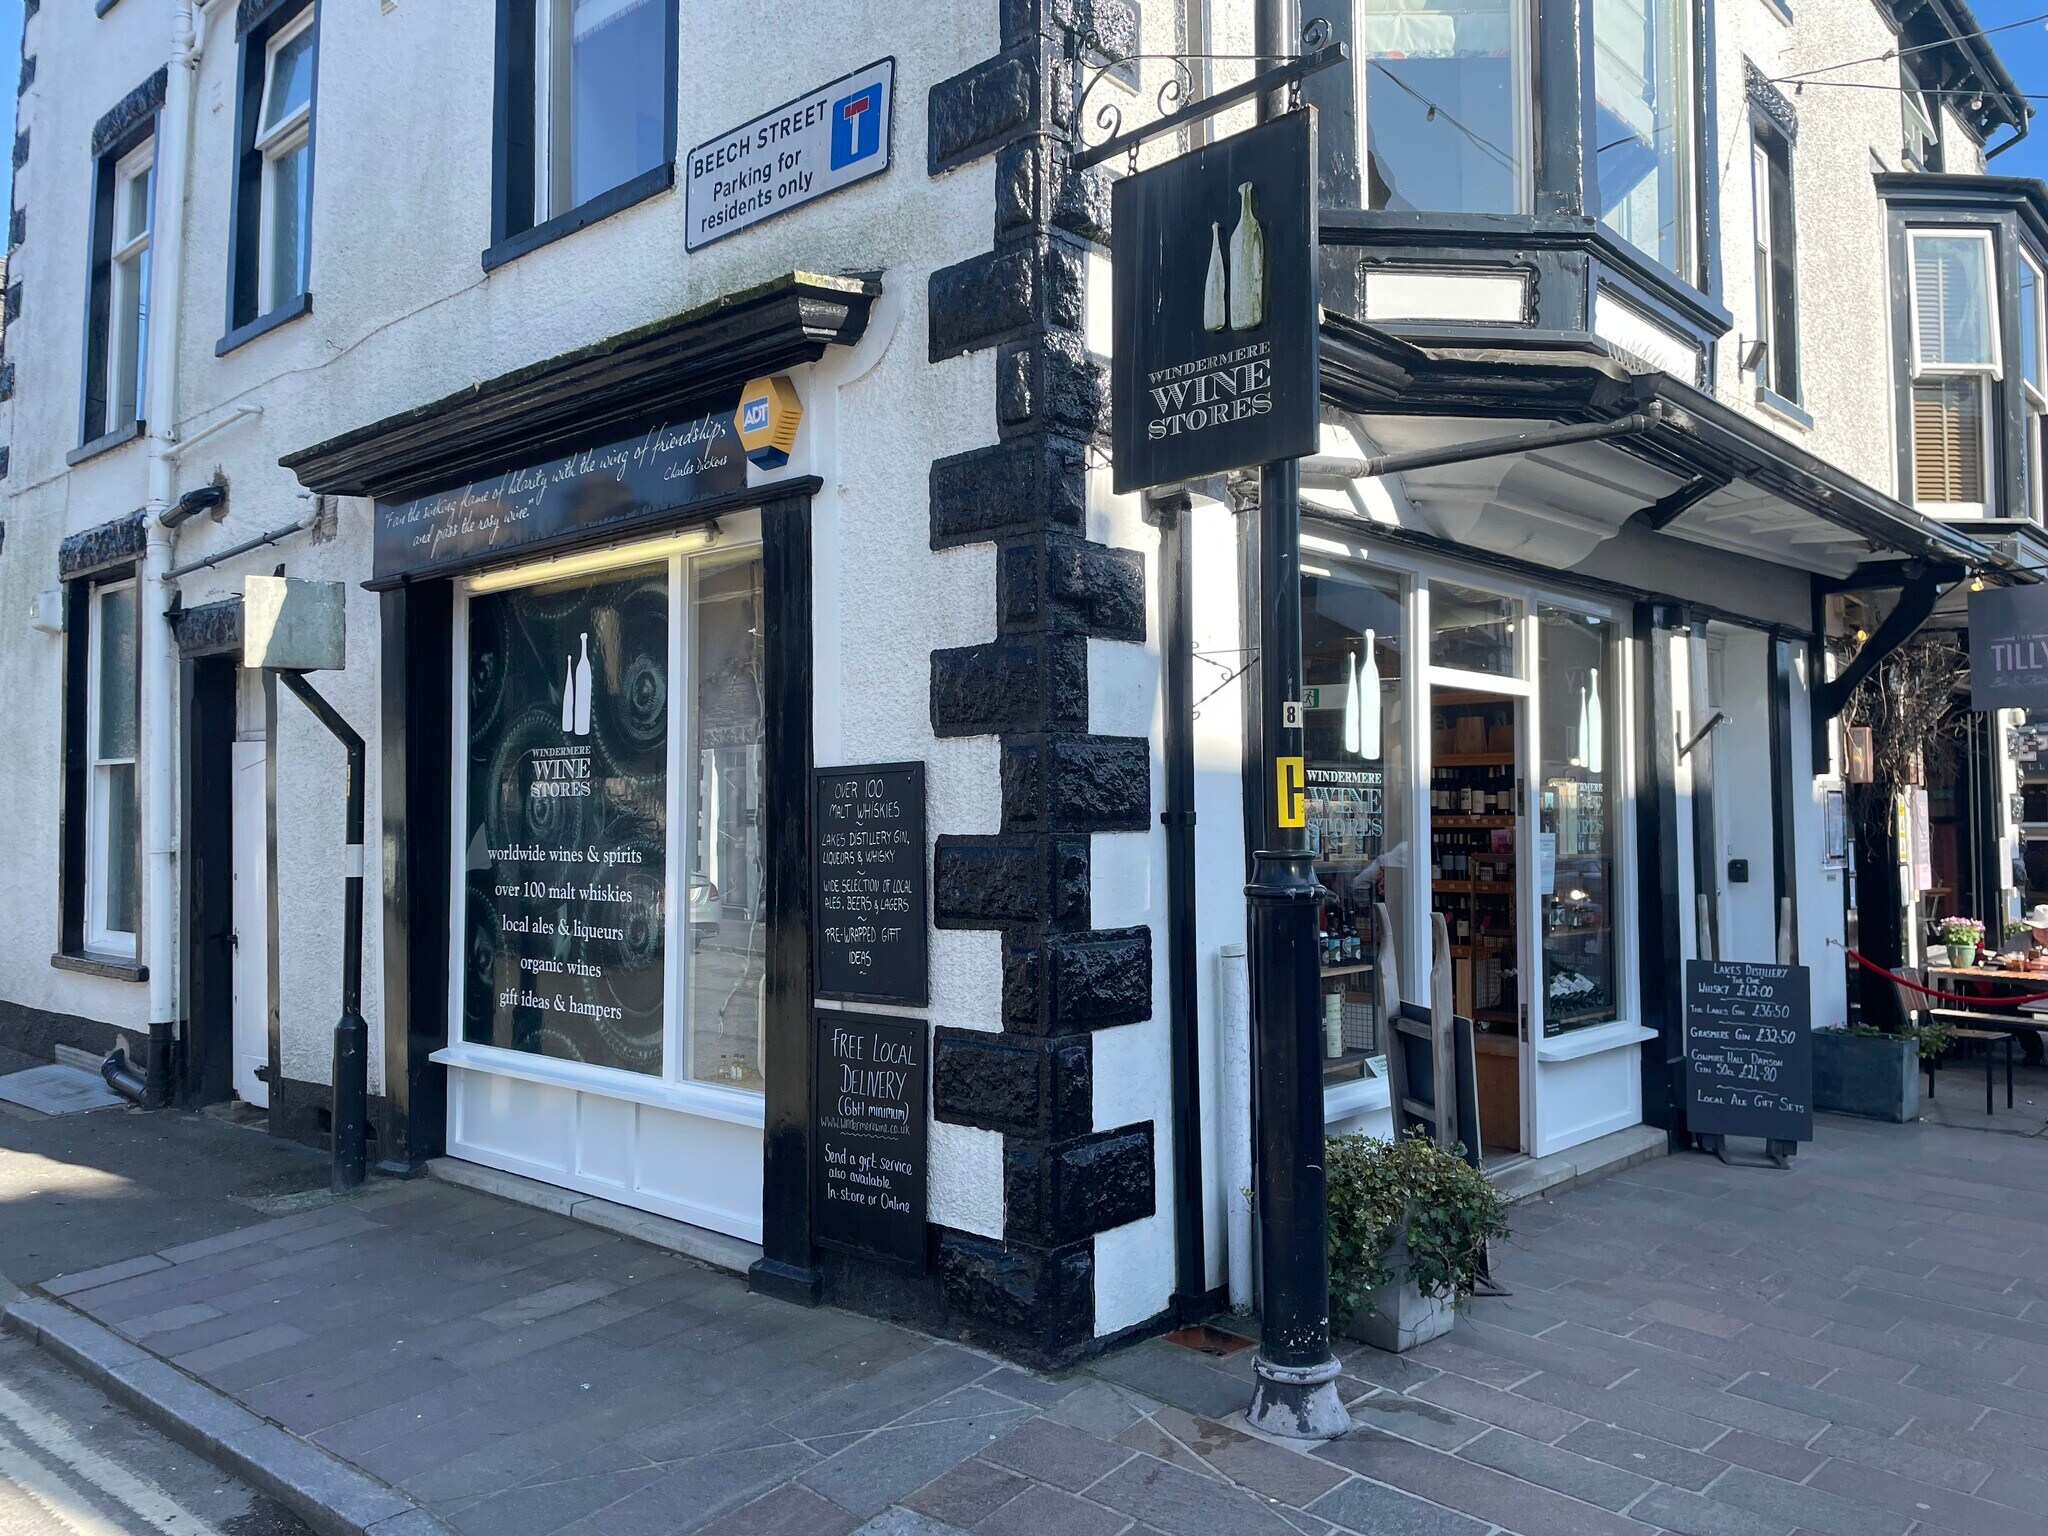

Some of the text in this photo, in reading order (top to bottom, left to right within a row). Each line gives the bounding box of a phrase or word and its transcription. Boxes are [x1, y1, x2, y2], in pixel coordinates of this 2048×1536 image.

[694, 99, 828, 179] BEECH STREET
[713, 150, 802, 201] Parking for
[701, 170, 813, 232] residents only
[1148, 341, 1271, 385] WINDERMERE
[1149, 358, 1271, 414] WINE
[744, 403, 769, 428] ADT
[1147, 391, 1273, 441] STORES
[407, 500, 420, 524] the
[423, 499, 457, 528] sinking
[458, 480, 489, 519] flame
[492, 469, 511, 508] of
[508, 468, 548, 506] hilarity
[552, 452, 578, 483] with
[579, 448, 596, 474] the
[600, 449, 629, 482] wing
[634, 425, 656, 469] of
[663, 455, 728, 481] Charles Dickens
[413, 523, 434, 546] and
[430, 527, 458, 559] pass
[461, 510, 475, 534] the
[477, 514, 500, 545] rosy
[1286, 705, 1297, 724] 8
[532, 745, 591, 757] WINDERMERE
[531, 758, 591, 780] WINE
[1305, 769, 1382, 784] WINDERMERE
[530, 781, 591, 798] STORES
[835, 779, 884, 799] OVER 100
[1307, 786, 1382, 814] WINE
[829, 800, 900, 819] MALT WHISKIES
[822, 832, 846, 847] LAKES
[849, 829, 892, 846] DISTILLERY
[1306, 817, 1383, 837] STORES
[488, 845, 642, 867] worldwide wines & spirits
[857, 851, 863, 866] &
[865, 848, 896, 864] WHISKY
[495, 882, 632, 904] over 100 malt whiskies
[823, 877, 913, 894] WIDE SELECTION OF LOCAL
[847, 896, 872, 911] BEERS
[874, 899, 879, 915] &
[880, 896, 910, 912] LAGERS
[502, 915, 624, 942] local ales & liqueurs
[824, 926, 901, 944] PRE-WRAPPED GIFT
[520, 956, 602, 978] organic wines
[848, 949, 872, 967] IDEAS
[1713, 963, 1788, 979] LAKES DISTILLERY
[1698, 982, 1730, 995] WHISKY
[500, 988, 622, 1021] gift ideas & hampers
[1689, 1004, 1703, 1013] THE
[1706, 1003, 1729, 1016] LAKES
[1731, 1004, 1746, 1016] GIN
[1690, 1027, 1730, 1040] GRASMERE
[1735, 1028, 1751, 1041] GIN
[831, 1027, 917, 1066] FREE LOCAL
[1694, 1062, 1711, 1073] GIN
[1727, 1051, 1745, 1064] HALL
[1751, 1053, 1783, 1067] DAMSON
[839, 1063, 908, 1101] DELIVERY
[1697, 1089, 1805, 1114] LOCAL ALE GIFT SETS
[868, 1101, 909, 1125] minimum)
[825, 1143, 913, 1176] Send a gift service
[828, 1167, 892, 1190] also available
[827, 1182, 911, 1214] In-store or Online
